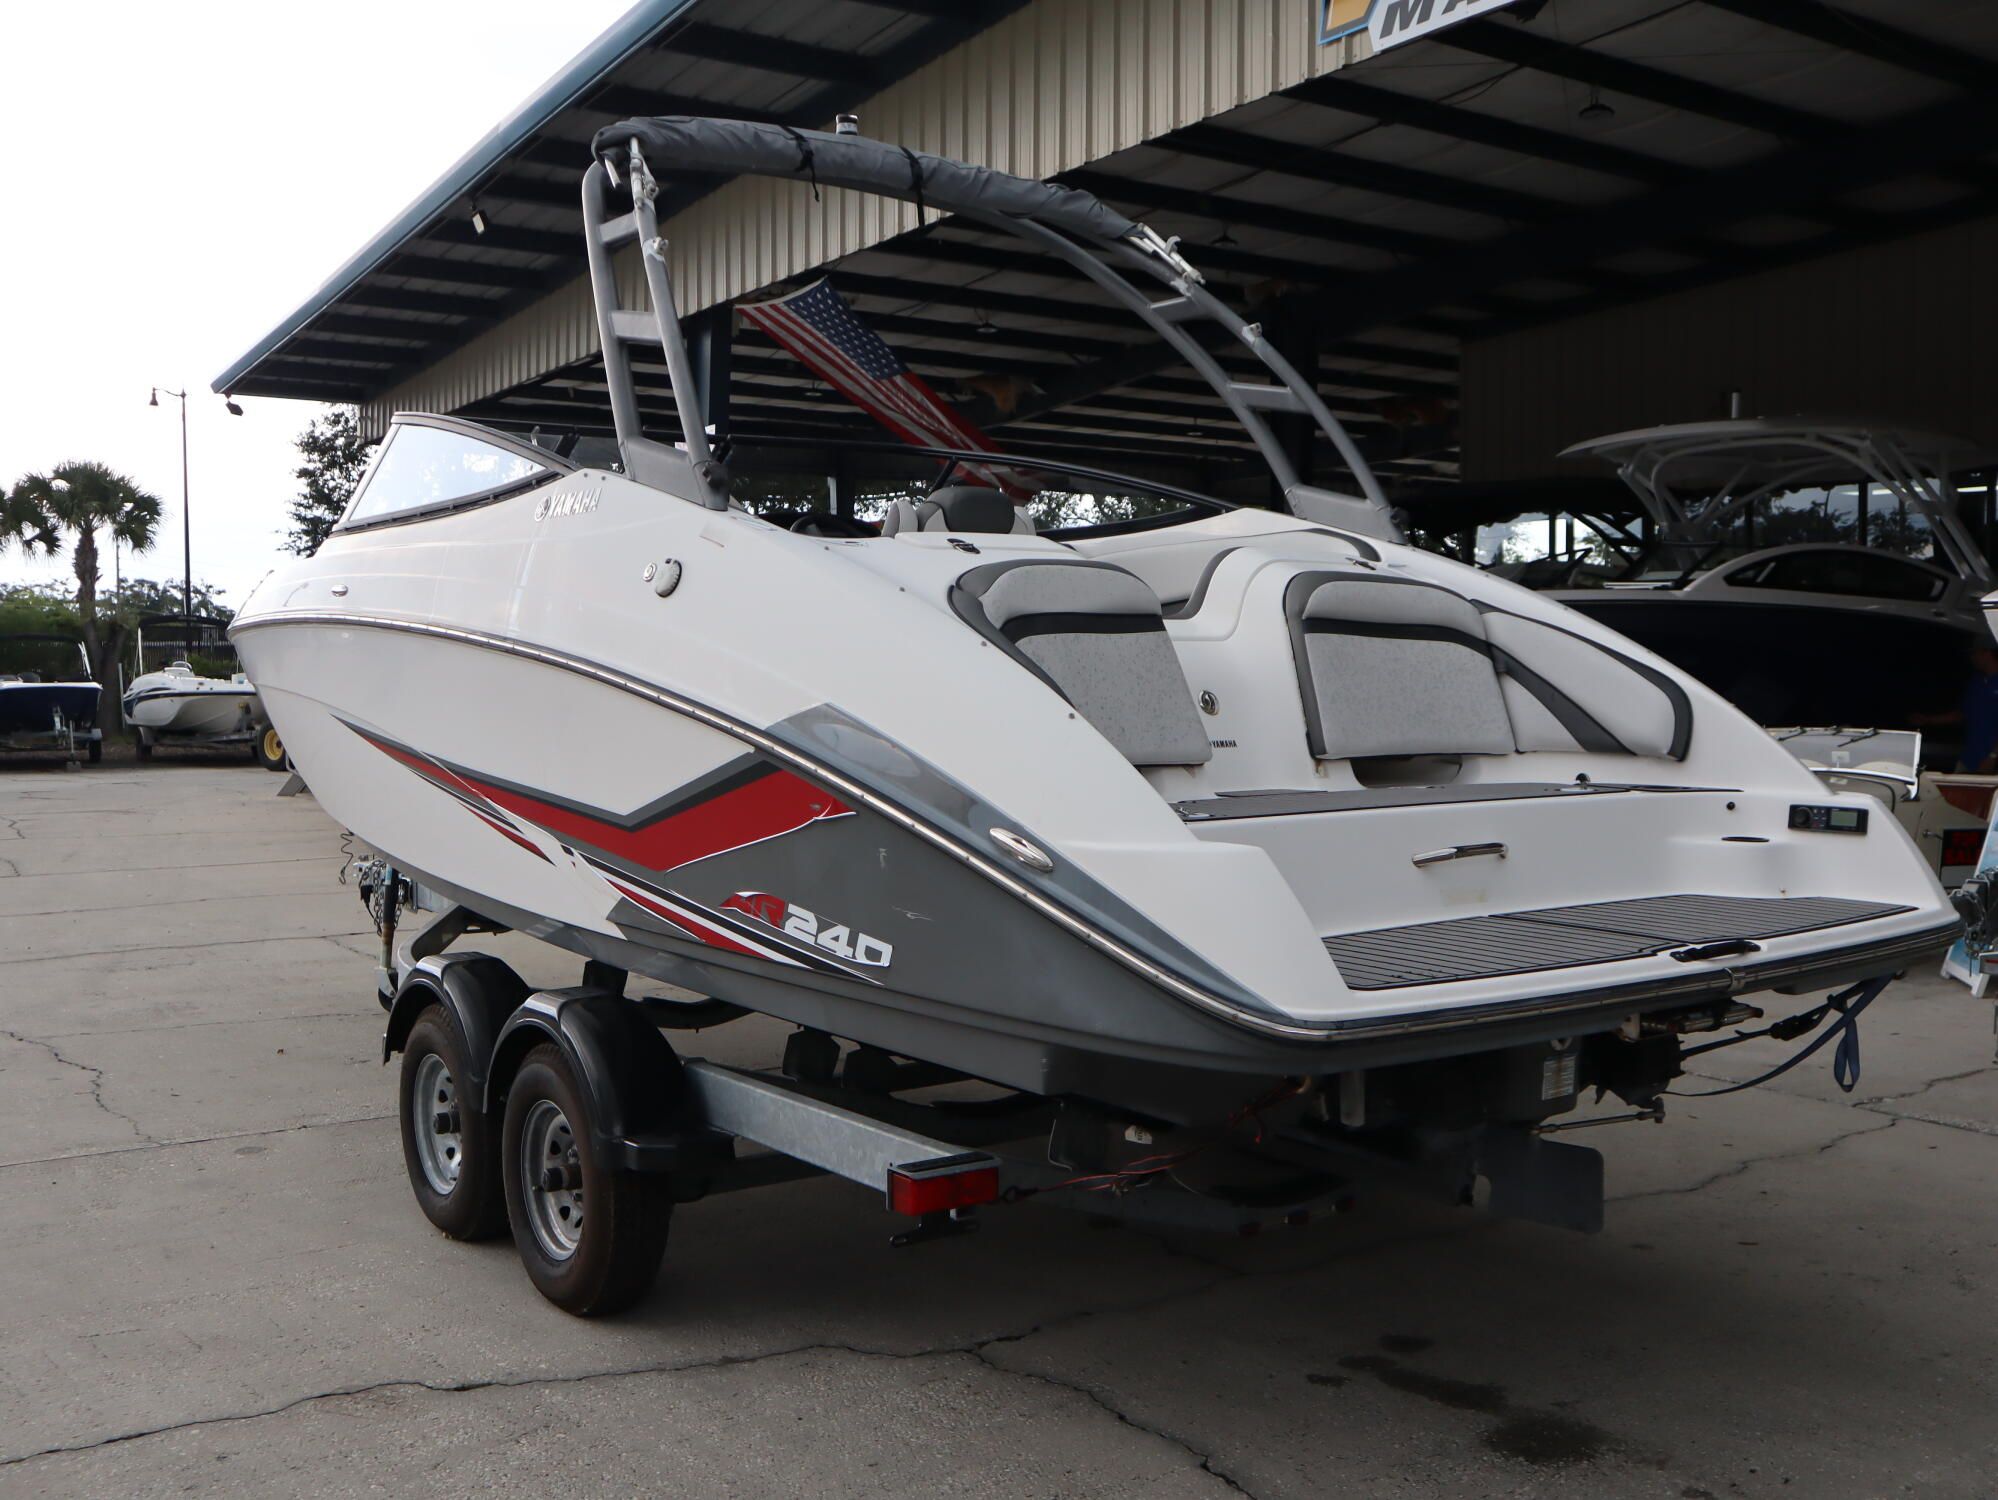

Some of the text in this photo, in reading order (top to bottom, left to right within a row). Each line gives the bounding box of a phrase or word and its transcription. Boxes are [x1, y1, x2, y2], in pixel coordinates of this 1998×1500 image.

[1380, 0, 1481, 38] M
[549, 488, 602, 516] YAMAHA
[1212, 740, 1237, 748] YAMAHA
